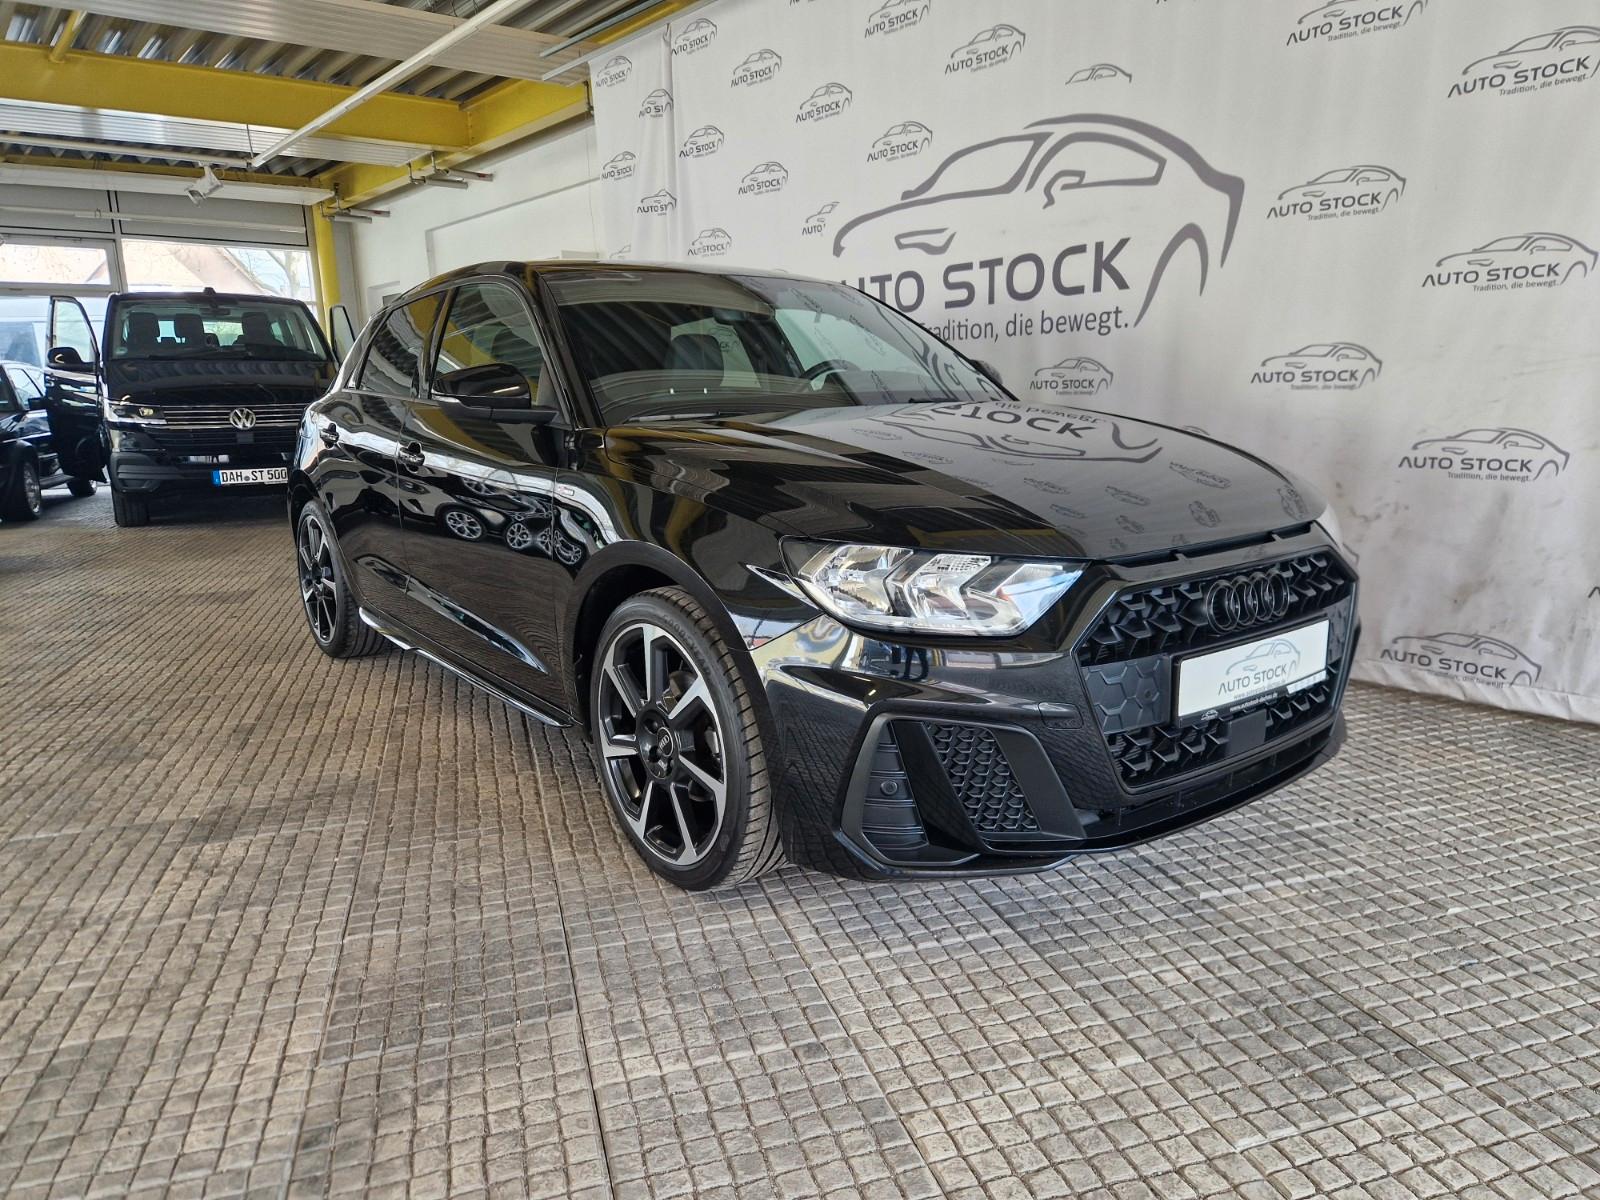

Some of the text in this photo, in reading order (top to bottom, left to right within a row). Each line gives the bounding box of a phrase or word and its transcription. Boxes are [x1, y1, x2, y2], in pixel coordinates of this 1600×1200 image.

[865, 21, 886, 38] AUTO
[888, 8, 918, 28] STOCK
[1286, 4, 1403, 46] AUTO STOCK
[689, 34, 709, 49] STOCK
[945, 58, 973, 74] AUTO
[976, 44, 1009, 65] STOCK
[610, 70, 626, 82] STOCK
[731, 74, 748, 88] AUTO
[749, 66, 773, 81] STOCK
[1447, 55, 1590, 98] AUTO STOCK
[1540, 80, 1553, 89] die
[796, 109, 815, 123] AUTO
[816, 100, 841, 116] STOCK
[695, 140, 716, 154] STOCK
[866, 148, 888, 162] AUTO
[890, 140, 918, 156] STOCK
[616, 165, 633, 176] STOCK
[738, 183, 756, 195] AUTO
[756, 178, 781, 191] STOCK
[1266, 191, 1382, 220] AUTO STOCK
[801, 224, 823, 236] AUTO
[942, 237, 1131, 310] STOCK
[1421, 262, 1561, 288] AUTO STOCK
[1511, 280, 1524, 289] die
[1006, 313, 1034, 337] die
[1040, 305, 1129, 336] bewegt.
[1030, 378, 1095, 390] AUTO STOCK
[1250, 368, 1359, 384] AUTO STOCK
[222, 468, 287, 482] DAH ST 500
[1398, 456, 1533, 472] AUTO STOCK
[1380, 648, 1432, 667] AUTO
[1438, 658, 1507, 680] STOCK
[1218, 675, 1251, 696] AUTO
[1253, 664, 1288, 685] STOCK
